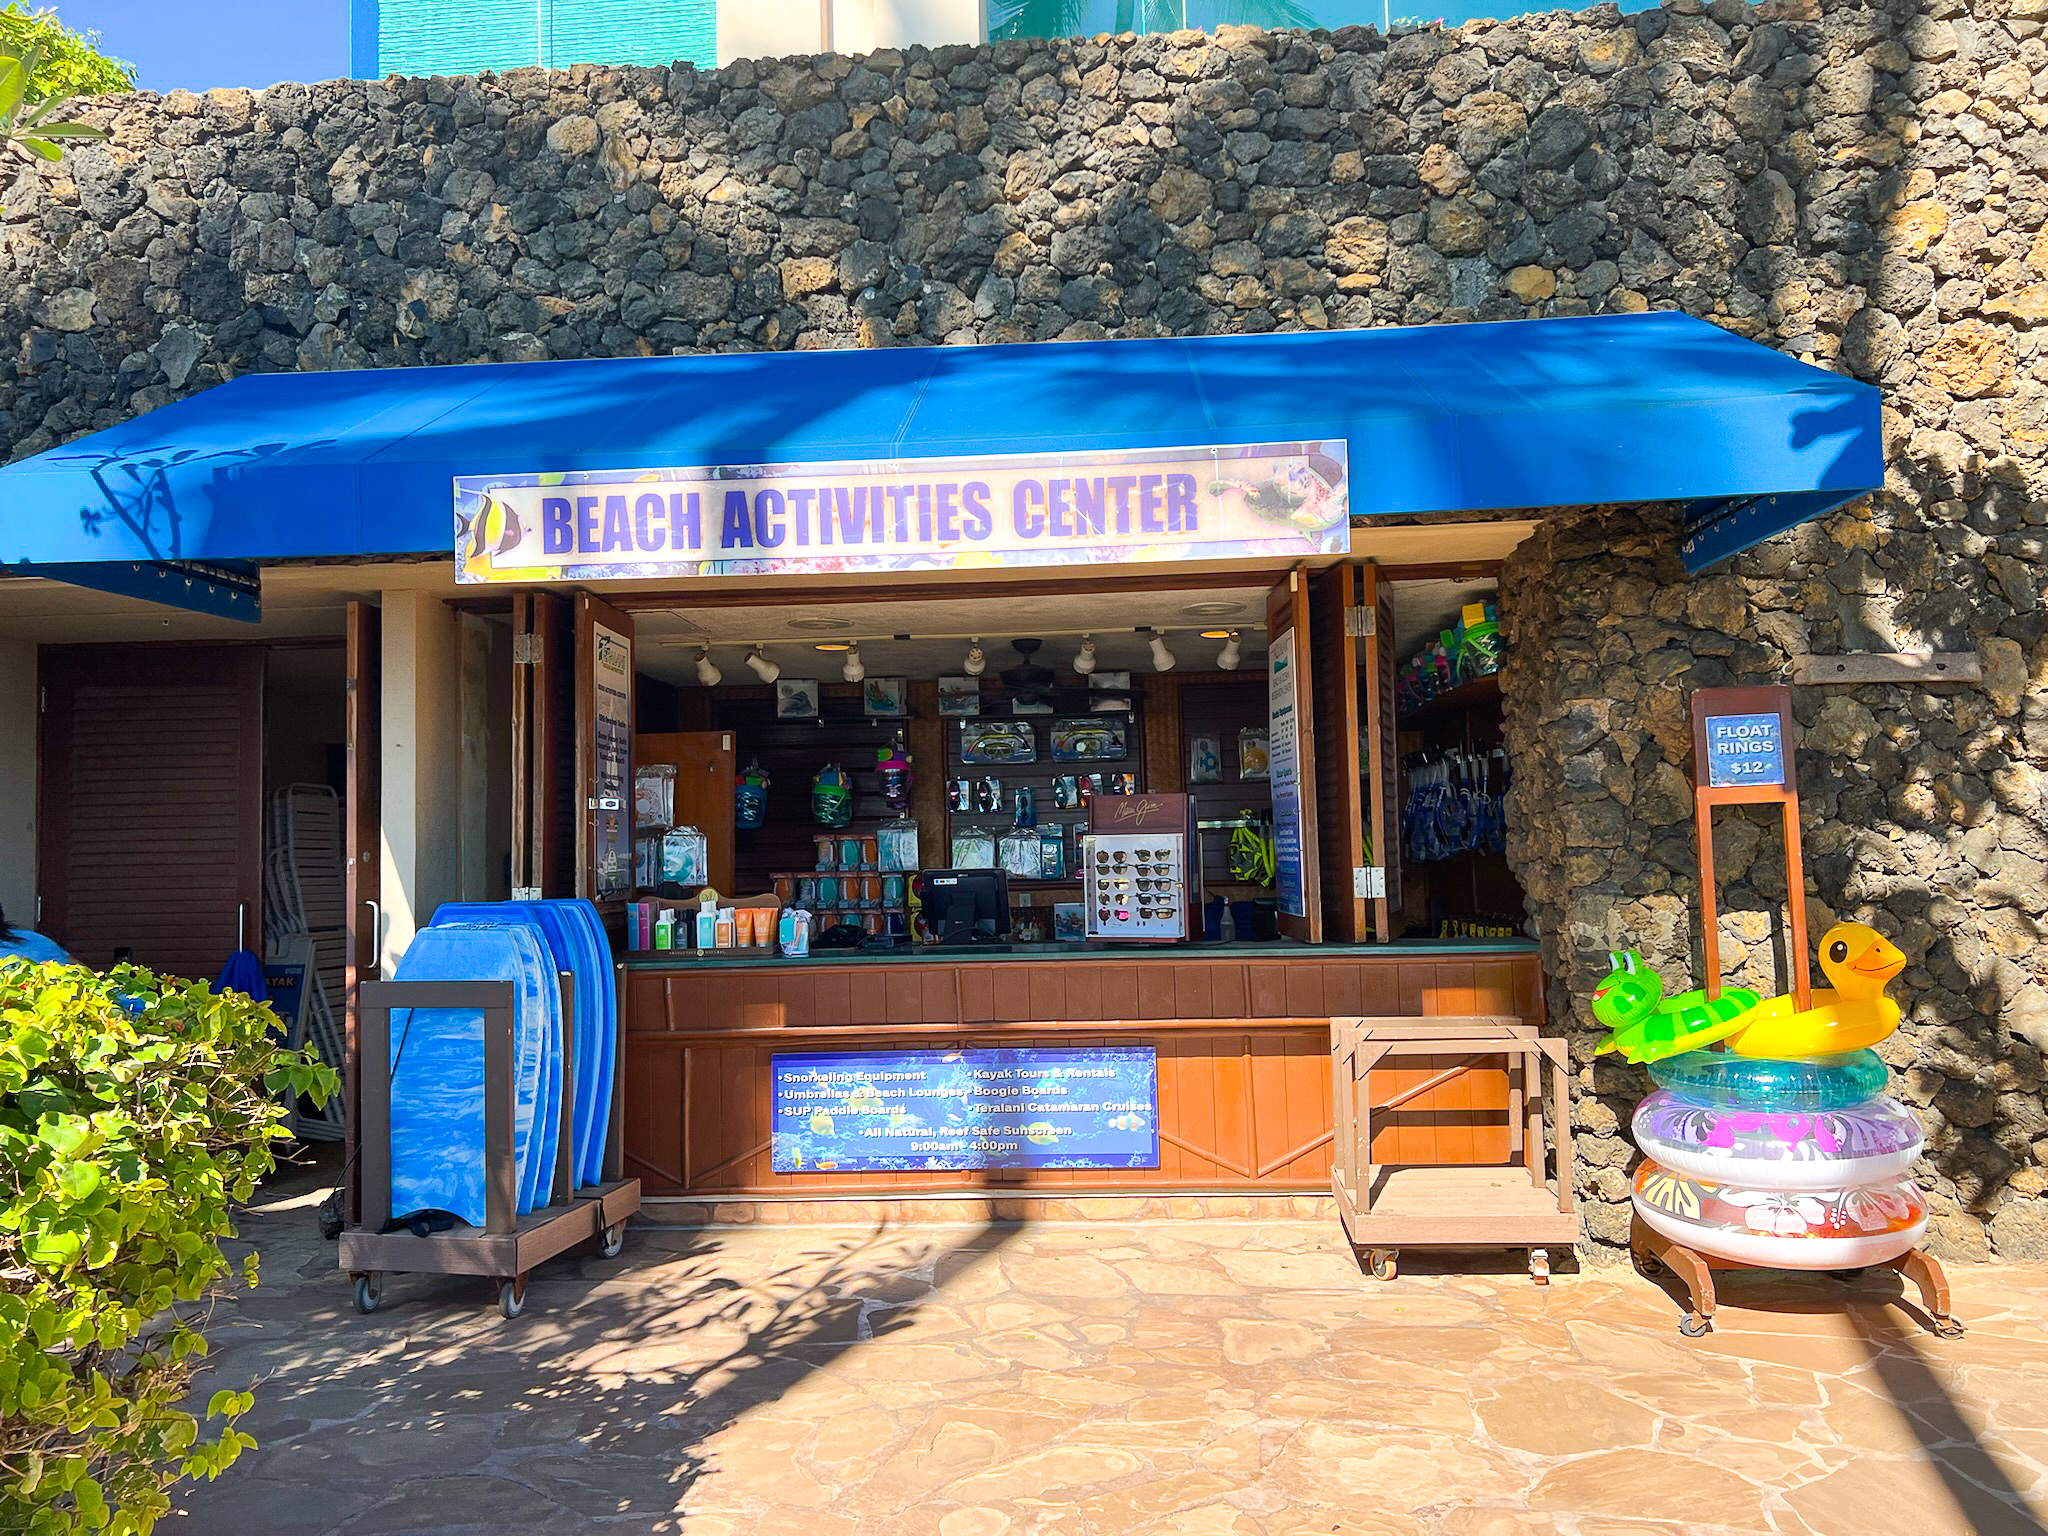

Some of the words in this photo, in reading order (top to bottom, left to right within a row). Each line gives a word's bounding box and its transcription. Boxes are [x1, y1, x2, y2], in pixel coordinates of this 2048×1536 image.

[543, 490, 701, 555] BEACH
[721, 480, 993, 549] ACTIVITIES
[1012, 472, 1200, 540] CENTER
[1716, 724, 1772, 738] FLOAT
[1717, 741, 1775, 755] RINGS
[1730, 761, 1764, 774] $12
[1114, 801, 1136, 818] Maui
[266, 977, 295, 987] AYAK
[784, 1072, 853, 1084] Snorkeling
[856, 1070, 927, 1082] Equipment
[973, 1069, 1013, 1081] Kayak
[1015, 1068, 1050, 1078] Tours
[1052, 1067, 1064, 1078] &
[1066, 1067, 1116, 1078] Rentals
[784, 1088, 850, 1100] Umbrellas
[852, 1089, 864, 1099] &
[865, 1087, 907, 1099] Beach
[908, 1087, 965, 1099] Lounges
[973, 1086, 1019, 1098] Boogie
[1021, 1085, 1068, 1096] Boards
[784, 1106, 811, 1116] SUP
[814, 1105, 858, 1116] Paddle
[860, 1104, 907, 1115] Boards
[974, 1102, 1025, 1113] Teralani
[1027, 1101, 1100, 1112] Catamaran
[1102, 1101, 1152, 1112] Cruises
[864, 1126, 882, 1138] All
[884, 1126, 937, 1138] Natural,
[939, 1125, 970, 1137] Reef
[971, 1125, 1001, 1137] Safe
[1003, 1125, 1073, 1136] Sunscreen
[910, 1140, 960, 1152] 9:00am
[969, 1140, 1019, 1152] 4:00pm
